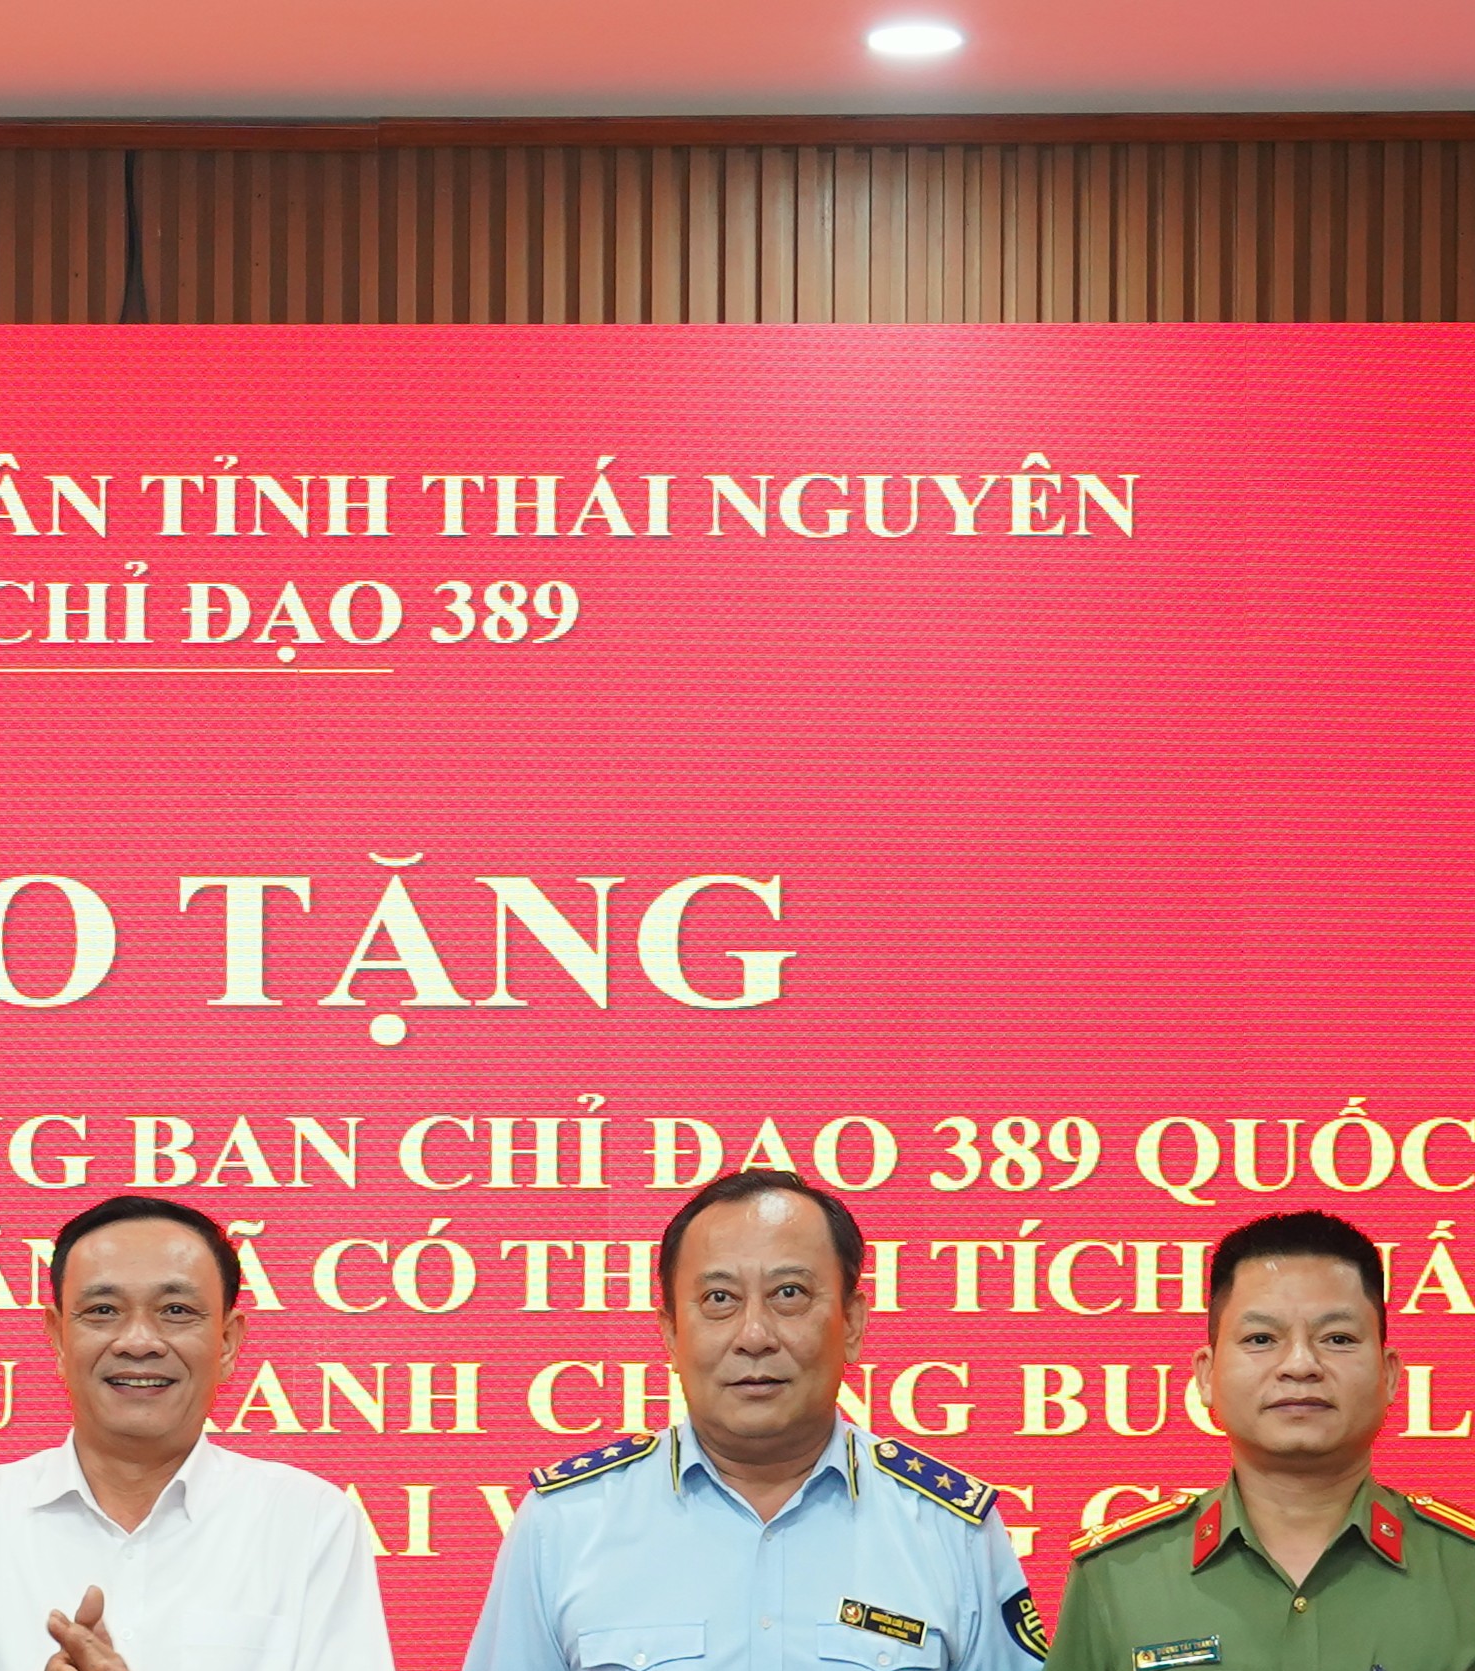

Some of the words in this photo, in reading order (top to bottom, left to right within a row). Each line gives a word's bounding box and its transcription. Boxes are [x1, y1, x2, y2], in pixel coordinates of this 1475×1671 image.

[142, 453, 391, 537] TỈNH
[423, 453, 674, 537] THÁI
[707, 452, 1139, 538] NGUYÊN
[183, 581, 402, 664] ĐẠO
[431, 581, 579, 643] 389
[180, 852, 797, 1046] TẶNG
[126, 1116, 362, 1189] BAN
[399, 1094, 612, 1190] CHỈ
[930, 1117, 1101, 1192] 389
[313, 1217, 477, 1313] CÓ
[930, 1219, 1214, 1315] TÍCH
